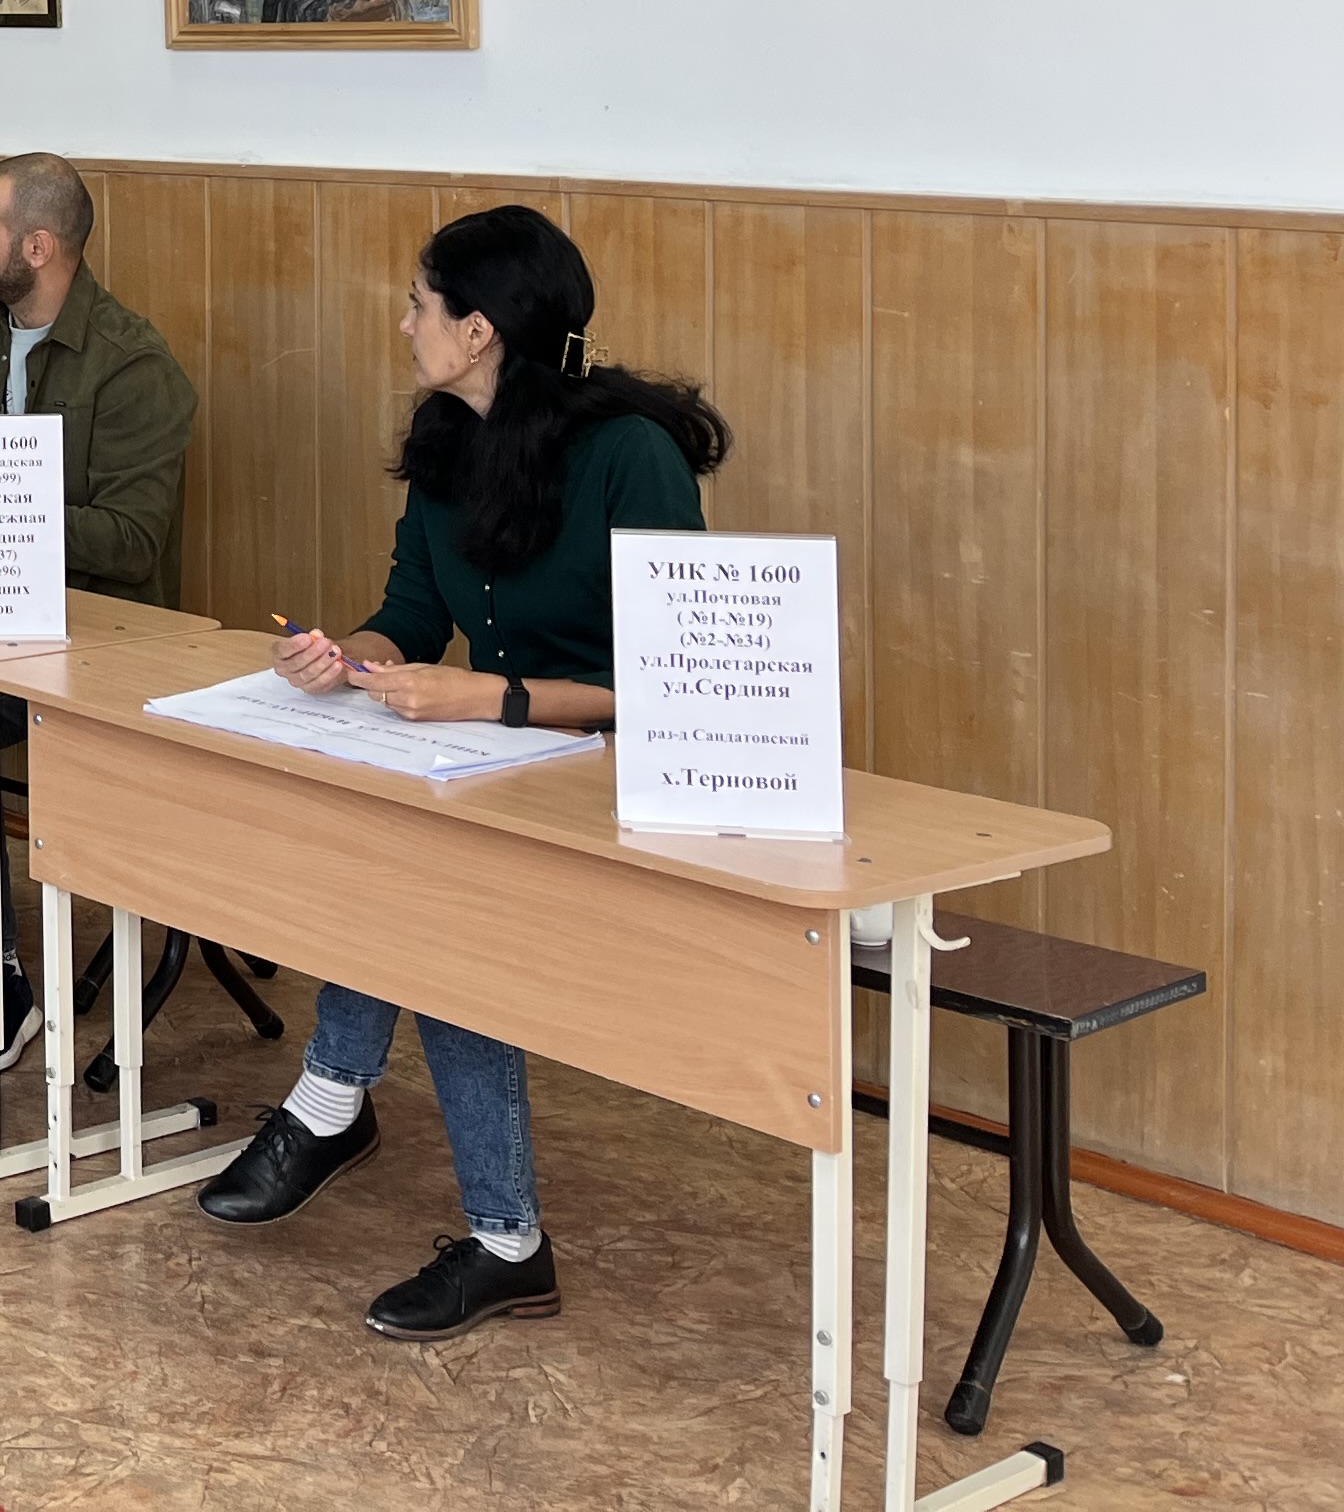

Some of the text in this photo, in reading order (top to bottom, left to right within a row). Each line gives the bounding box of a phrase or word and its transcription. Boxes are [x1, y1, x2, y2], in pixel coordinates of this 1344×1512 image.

[1, 436, 38, 450] 1600
[647, 561, 801, 584] УИК № 1600
[666, 589, 782, 607] ул.Почтовая
[679, 632, 771, 650] (№2-№34)
[639, 652, 813, 675] ул.Пролетарская
[663, 678, 791, 701] ул.Сердняя
[647, 727, 810, 746] раз-д Сандатовский
[661, 767, 799, 792] х.Терновой
